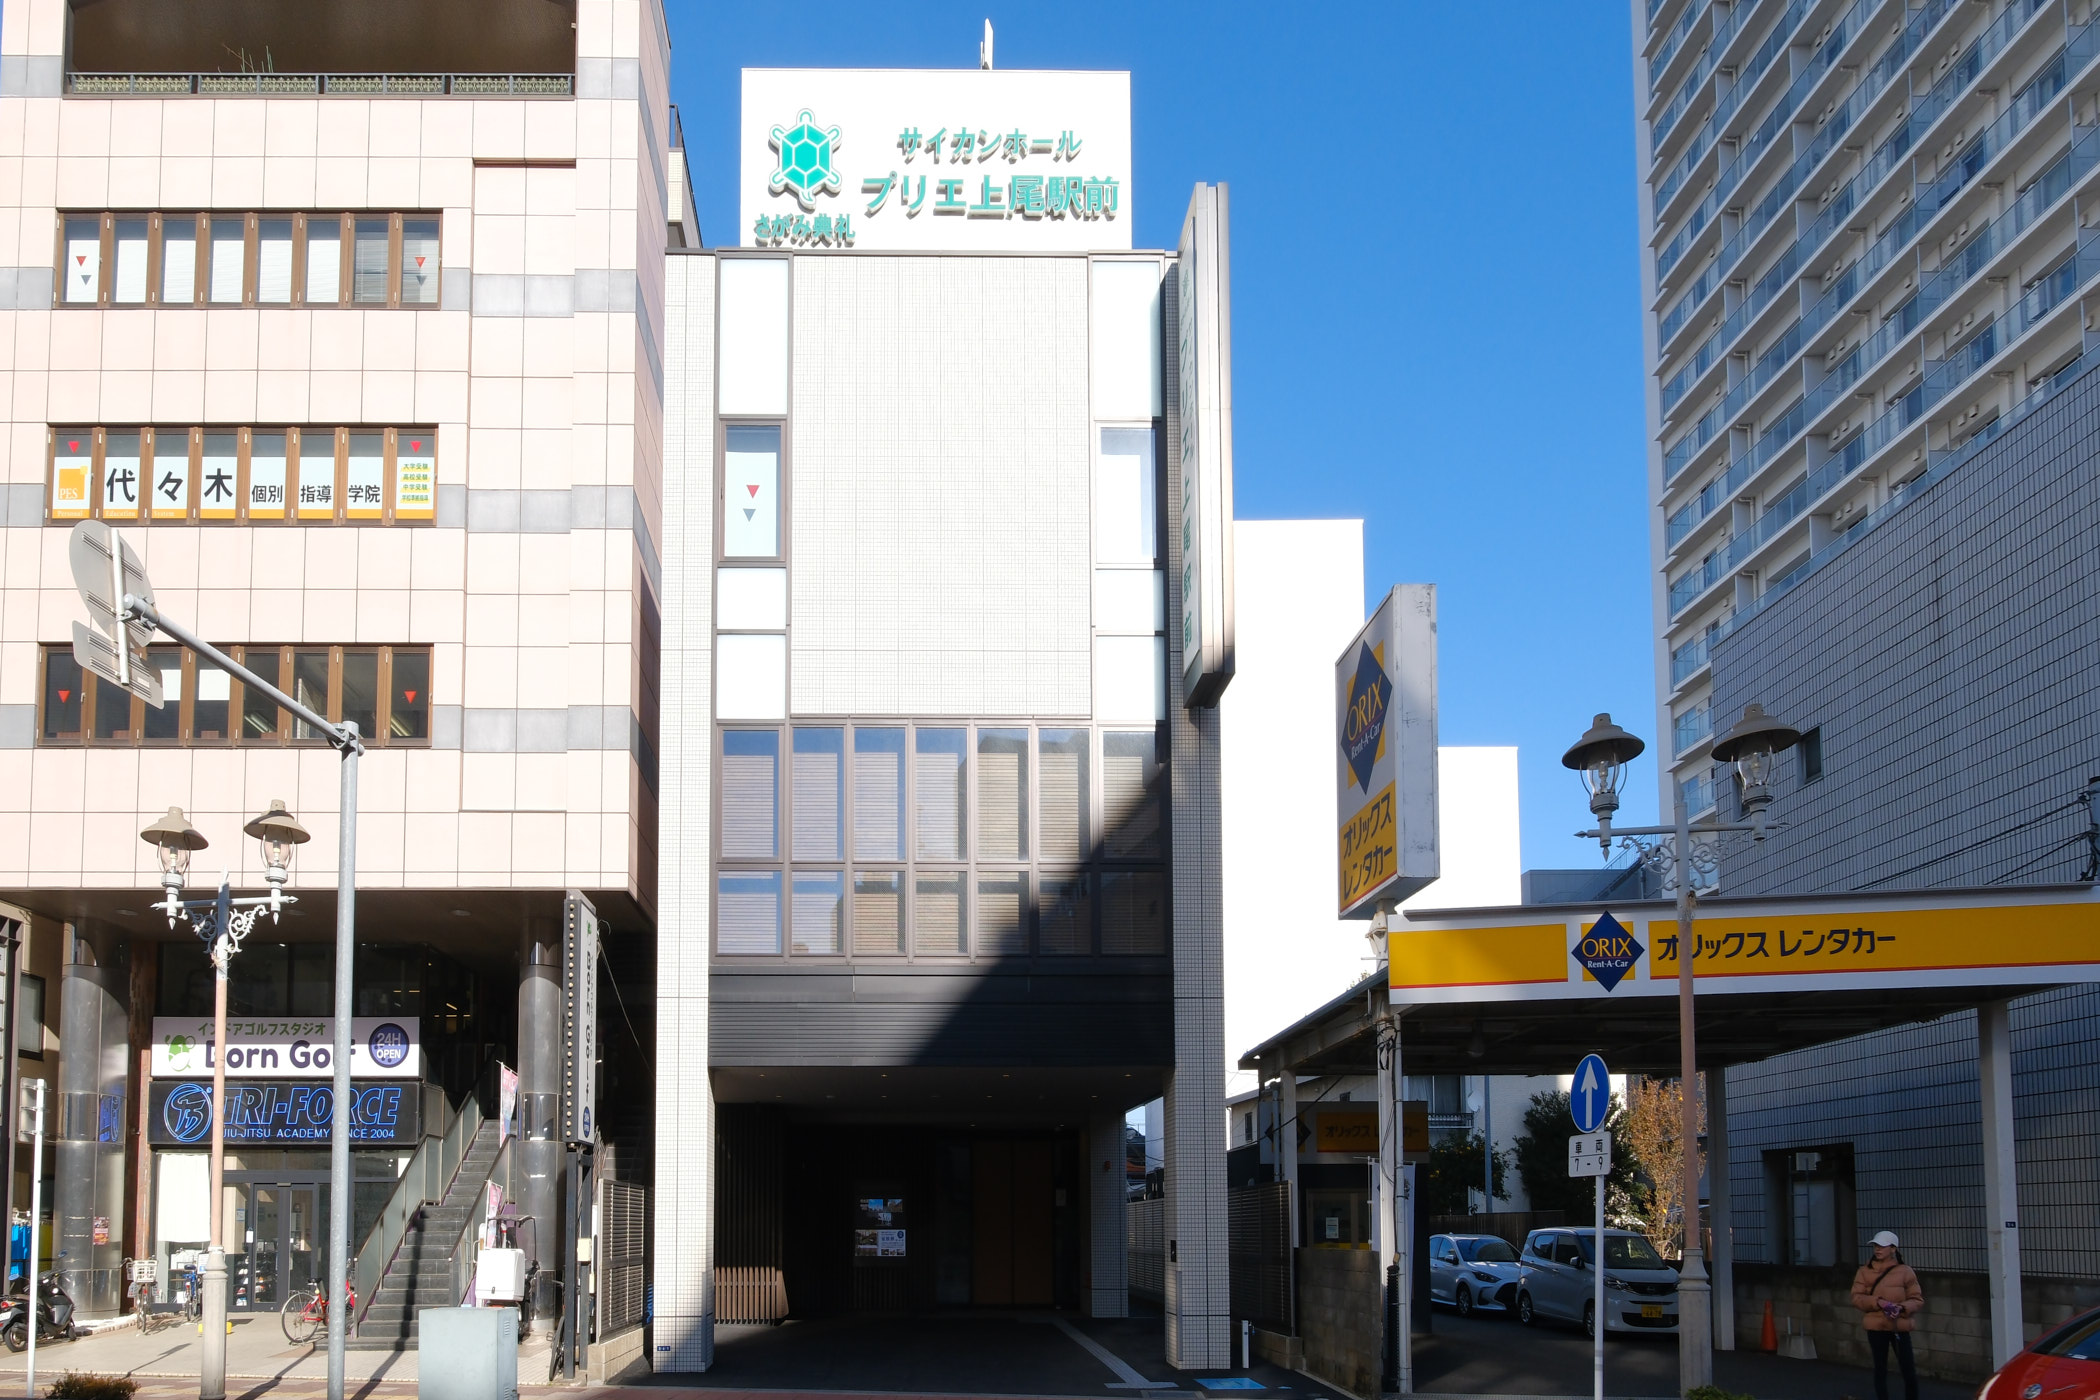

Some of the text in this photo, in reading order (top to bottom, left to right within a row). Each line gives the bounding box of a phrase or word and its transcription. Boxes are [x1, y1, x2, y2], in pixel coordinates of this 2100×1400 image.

[899, 126, 1083, 161] サイカンホール
[862, 170, 1120, 217] プリエ上尾駅前
[754, 212, 856, 245] さがみ典礼
[59, 488, 78, 499] PES
[1180, 329, 1193, 651] プリエ上尾駅前
[1347, 674, 1383, 741] ORIX
[1351, 720, 1382, 761] Rent-A-Car
[1343, 791, 1391, 859] オリックス
[1343, 844, 1393, 902] レンタカー
[1581, 937, 1632, 958] ORIX
[1779, 928, 1896, 956] レンタカー
[1587, 960, 1629, 968] Rent-A-Car
[289, 1040, 356, 1068] Go
[376, 1032, 401, 1047] 24H
[376, 1049, 401, 1059] OPEN
[276, 1129, 331, 1138] ACADEMY
[370, 1129, 395, 1138] 2004
